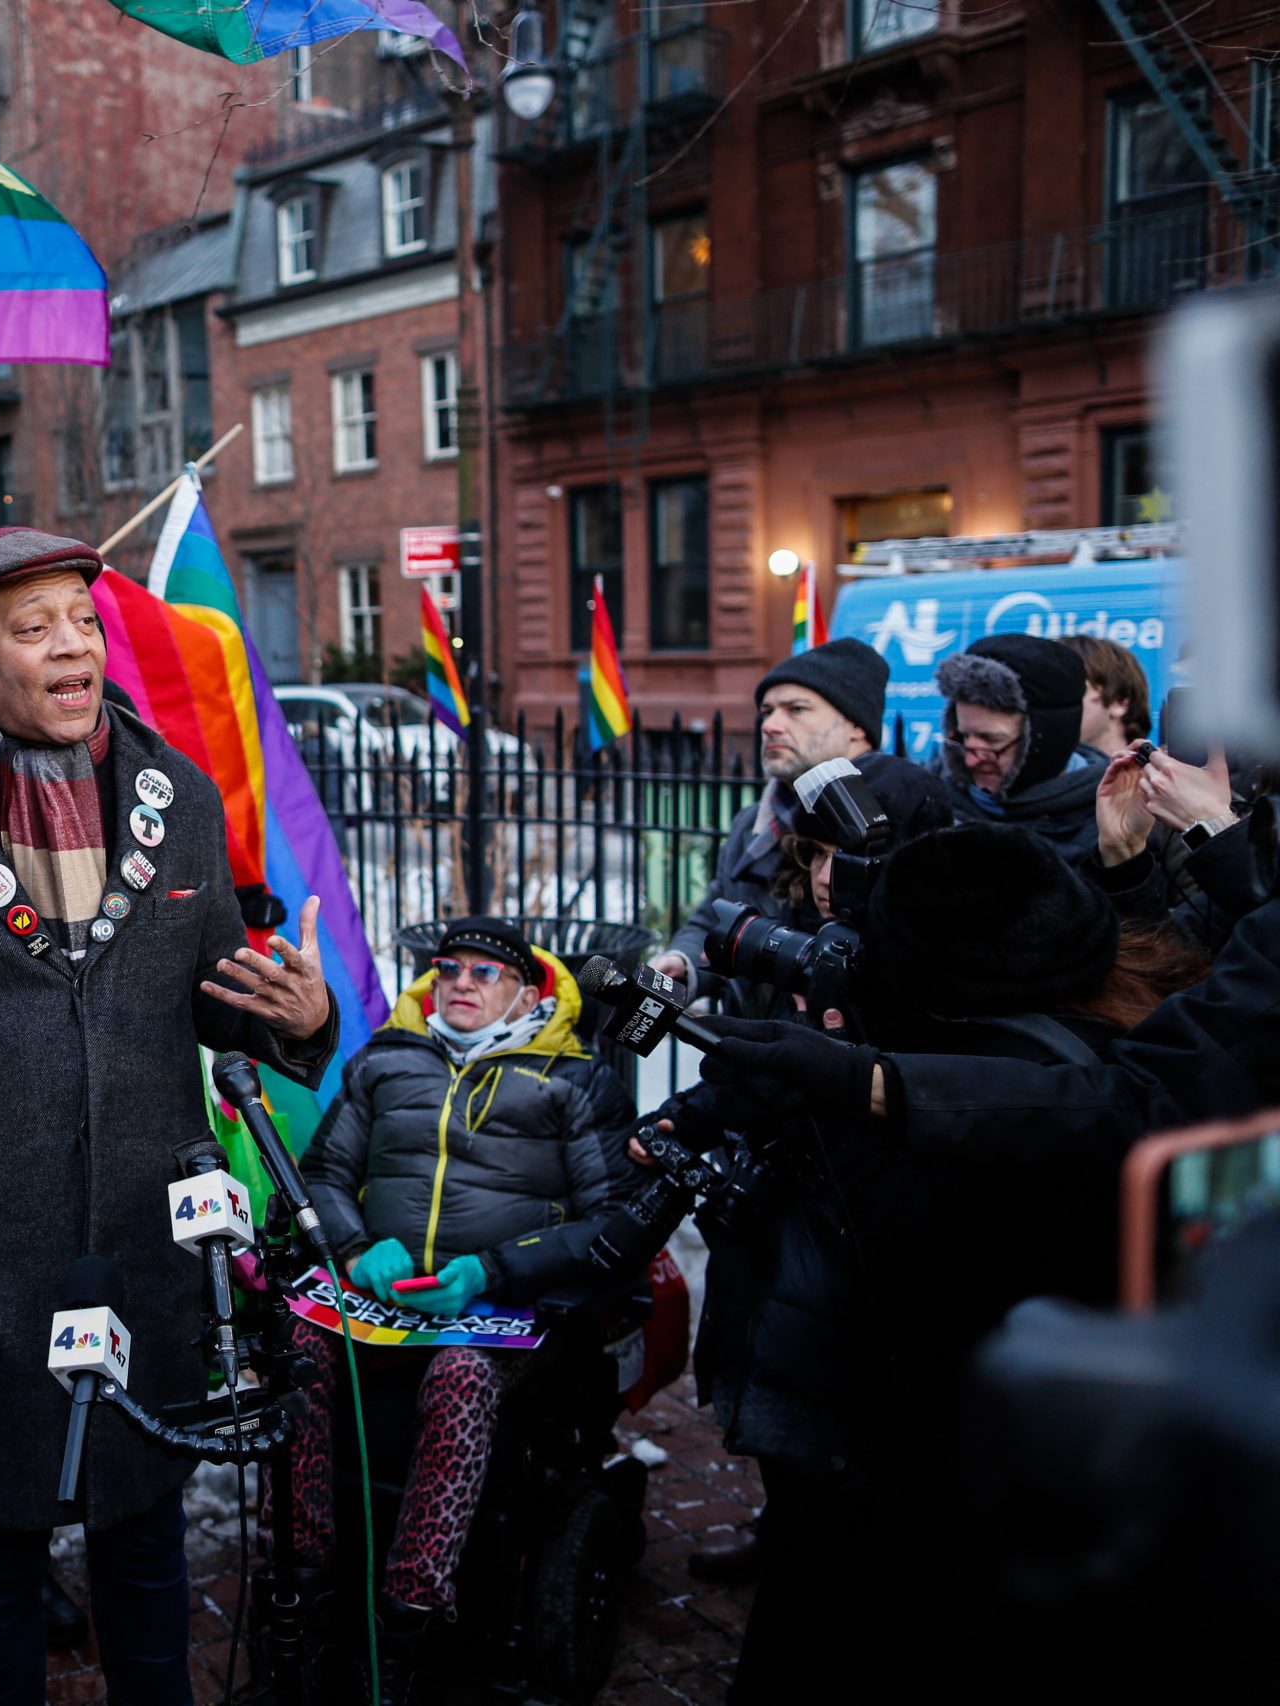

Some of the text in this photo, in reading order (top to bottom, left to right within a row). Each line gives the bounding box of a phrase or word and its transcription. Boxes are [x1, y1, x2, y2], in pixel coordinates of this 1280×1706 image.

[139, 779, 172, 805] OFF!
[142, 771, 174, 795] HANDS
[139, 812, 160, 841] T
[133, 850, 157, 878] QUEER
[92, 924, 112, 937] NO
[652, 1002, 662, 1010] 1
[616, 1011, 644, 1043] SPECTRUM
[629, 1016, 655, 1044] NEWS
[175, 1194, 197, 1221] 4
[238, 1208, 249, 1224] 47
[306, 1289, 532, 1336] OUR FLAGS!
[315, 1281, 421, 1320] BRING
[53, 1325, 76, 1350] 4
[116, 1350, 126, 1368] 47
